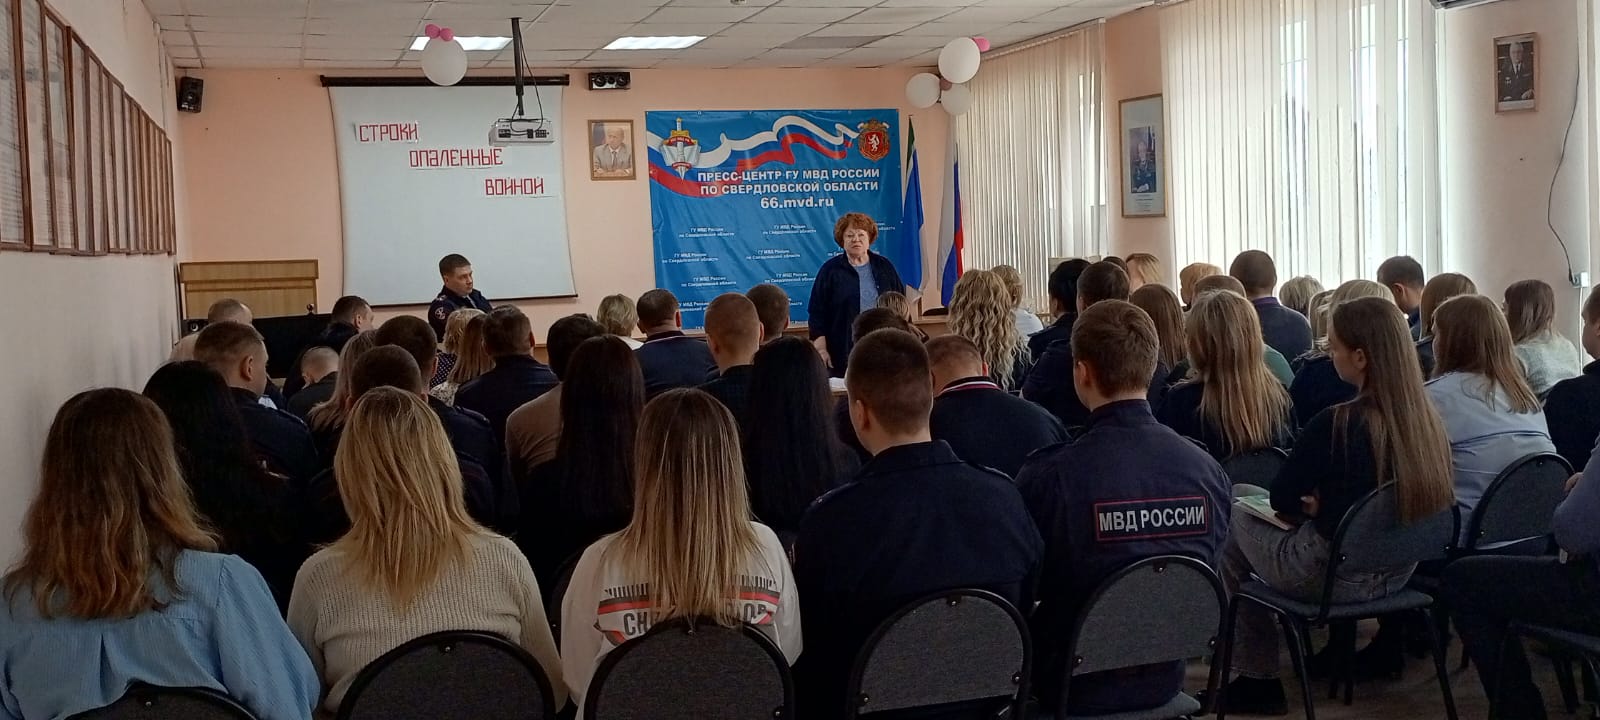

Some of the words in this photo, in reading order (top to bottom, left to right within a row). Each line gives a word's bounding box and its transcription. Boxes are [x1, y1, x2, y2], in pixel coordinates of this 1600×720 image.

[359, 123, 418, 142] СТРОКИ
[409, 148, 503, 167] ОПАЛЕННЫЕ
[697, 171, 781, 183] ПРЕСС-ЦЕНТР
[785, 170, 799, 182] ГУ
[802, 169, 829, 181] МВД
[832, 168, 880, 179] РОССИИ
[485, 176, 544, 196] ВОЙНОЙ
[700, 184, 718, 195] ПО
[721, 182, 820, 195] СВЕРДЛОВСКОЙ
[823, 181, 879, 192] ОБЛАСТИ
[760, 196, 834, 209] 66.mvd.ru
[1099, 510, 1139, 532] МВД
[1140, 506, 1205, 529] РОССИИ
